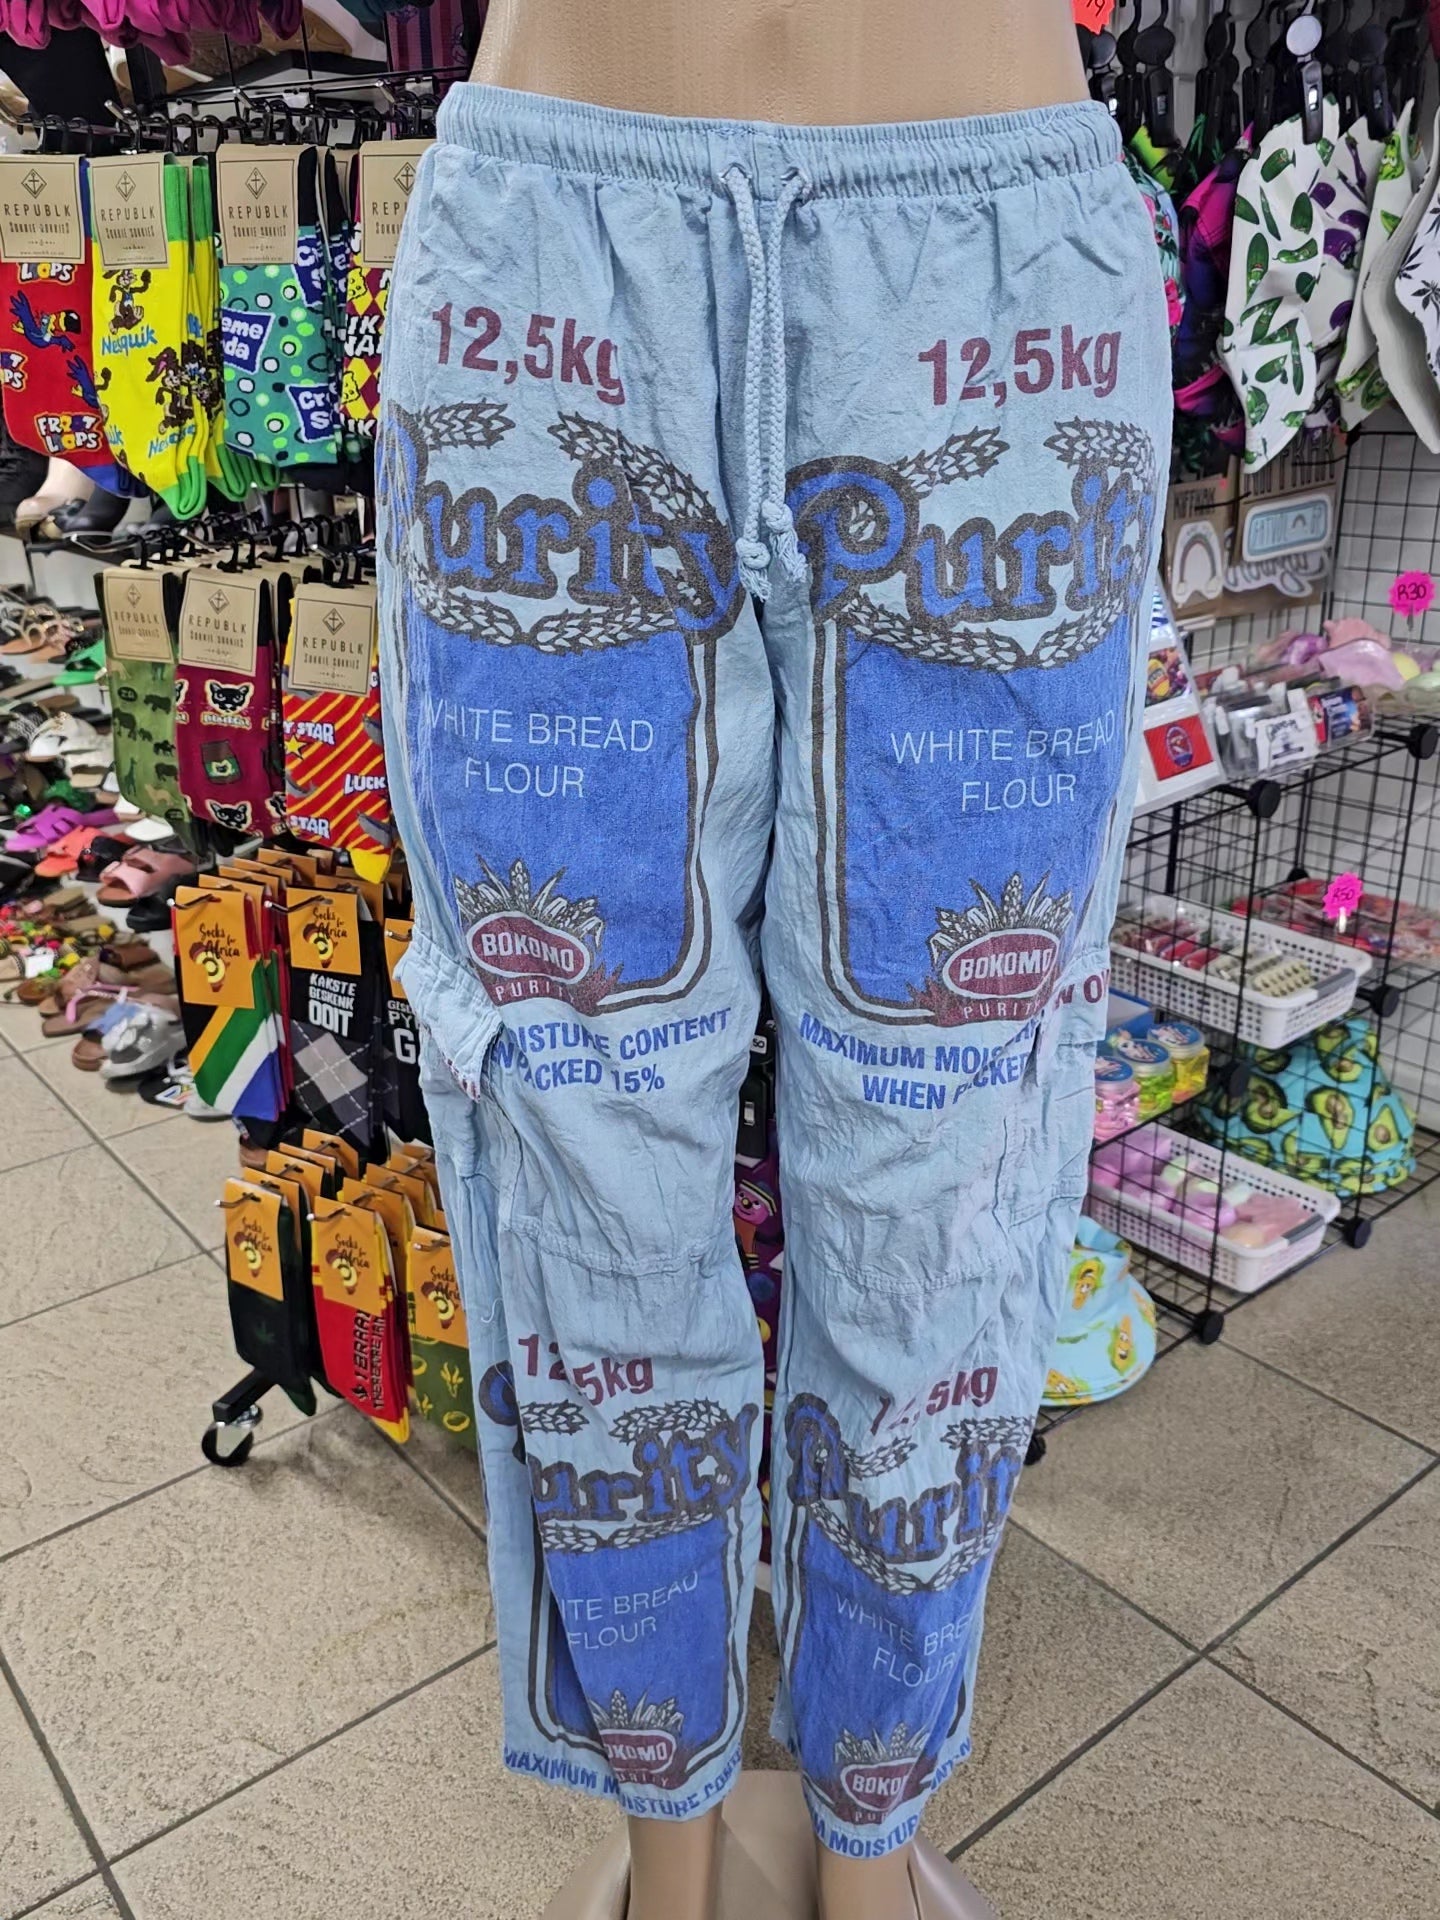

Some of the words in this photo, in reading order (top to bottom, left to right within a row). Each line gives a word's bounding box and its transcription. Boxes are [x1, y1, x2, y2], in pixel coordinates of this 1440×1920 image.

[3, 203, 71, 217] REPUBLK
[100, 206, 156, 222] REPUBLK
[228, 205, 288, 220] REPUBLK
[432, 302, 625, 405] 12,5kg
[918, 324, 1122, 409] 12,5kg
[783, 455, 1157, 628] Purit
[1397, 582, 1427, 601] R30
[188, 614, 248, 635] REPUBLK
[302, 636, 364, 656] REPUBLK
[296, 722, 335, 745] STAR
[528, 712, 655, 753] BREAD
[890, 728, 1013, 765] WHITE
[1025, 708, 1116, 759] BREAD
[465, 756, 586, 799] FLOUR
[960, 773, 1078, 813] FLOUR
[289, 815, 331, 840] STAR
[481, 931, 576, 974] BOKOMO
[959, 945, 1056, 984] BOKOMO
[307, 985, 356, 1012] GESKENK
[308, 971, 358, 998] KAKSTE
[307, 998, 354, 1039] OOIT
[619, 1008, 732, 1061] CONTENT
[799, 1012, 926, 1069] MAXIMUM
[610, 1063, 665, 1094] 15%
[861, 1074, 946, 1110] WHEN
[952, 1051, 1032, 1105] PCKED
[568, 1616, 657, 1650] FLOUR
[836, 1592, 915, 1652] WHITE
[872, 1646, 957, 1688] FLOUR
[504, 1746, 597, 1790] MAXIMUM
[852, 1773, 909, 1798] BOKO
